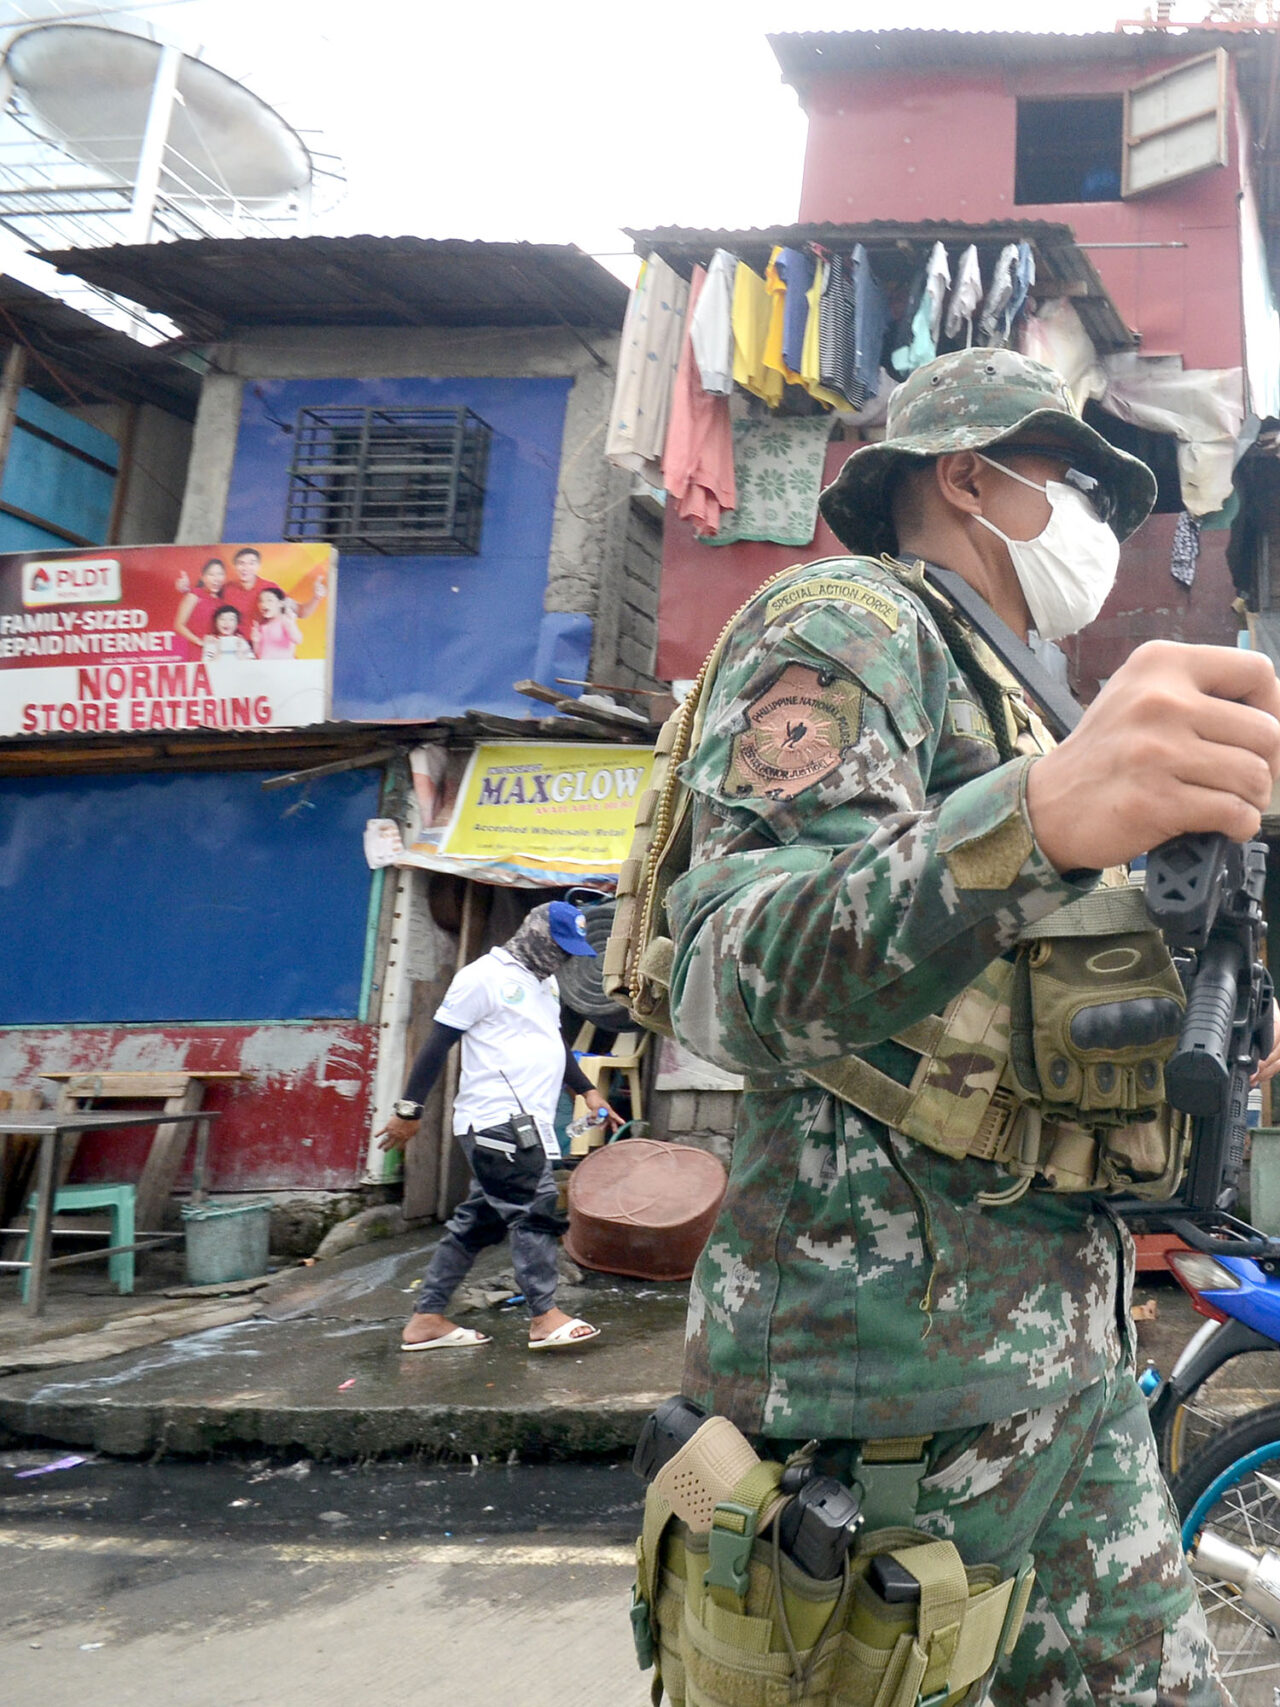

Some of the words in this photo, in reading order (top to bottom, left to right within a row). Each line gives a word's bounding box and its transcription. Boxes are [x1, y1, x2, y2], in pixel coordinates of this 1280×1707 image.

[56, 568, 111, 587] PLDT
[771, 587, 814, 611] SPECIAL
[819, 584, 858, 599] ACTION
[862, 593, 894, 617] FORCE
[1, 609, 148, 634] FAMILY-SIZED
[0, 633, 65, 658] EPAID
[64, 631, 176, 654] INTERNET
[77, 663, 213, 701] NORMA
[23, 701, 119, 732] STORE
[131, 695, 272, 728] EATERING
[752, 696, 798, 722] PHILIPPINE
[800, 697, 840, 718] NATIONAL
[477, 767, 646, 806] MAXGLOW
